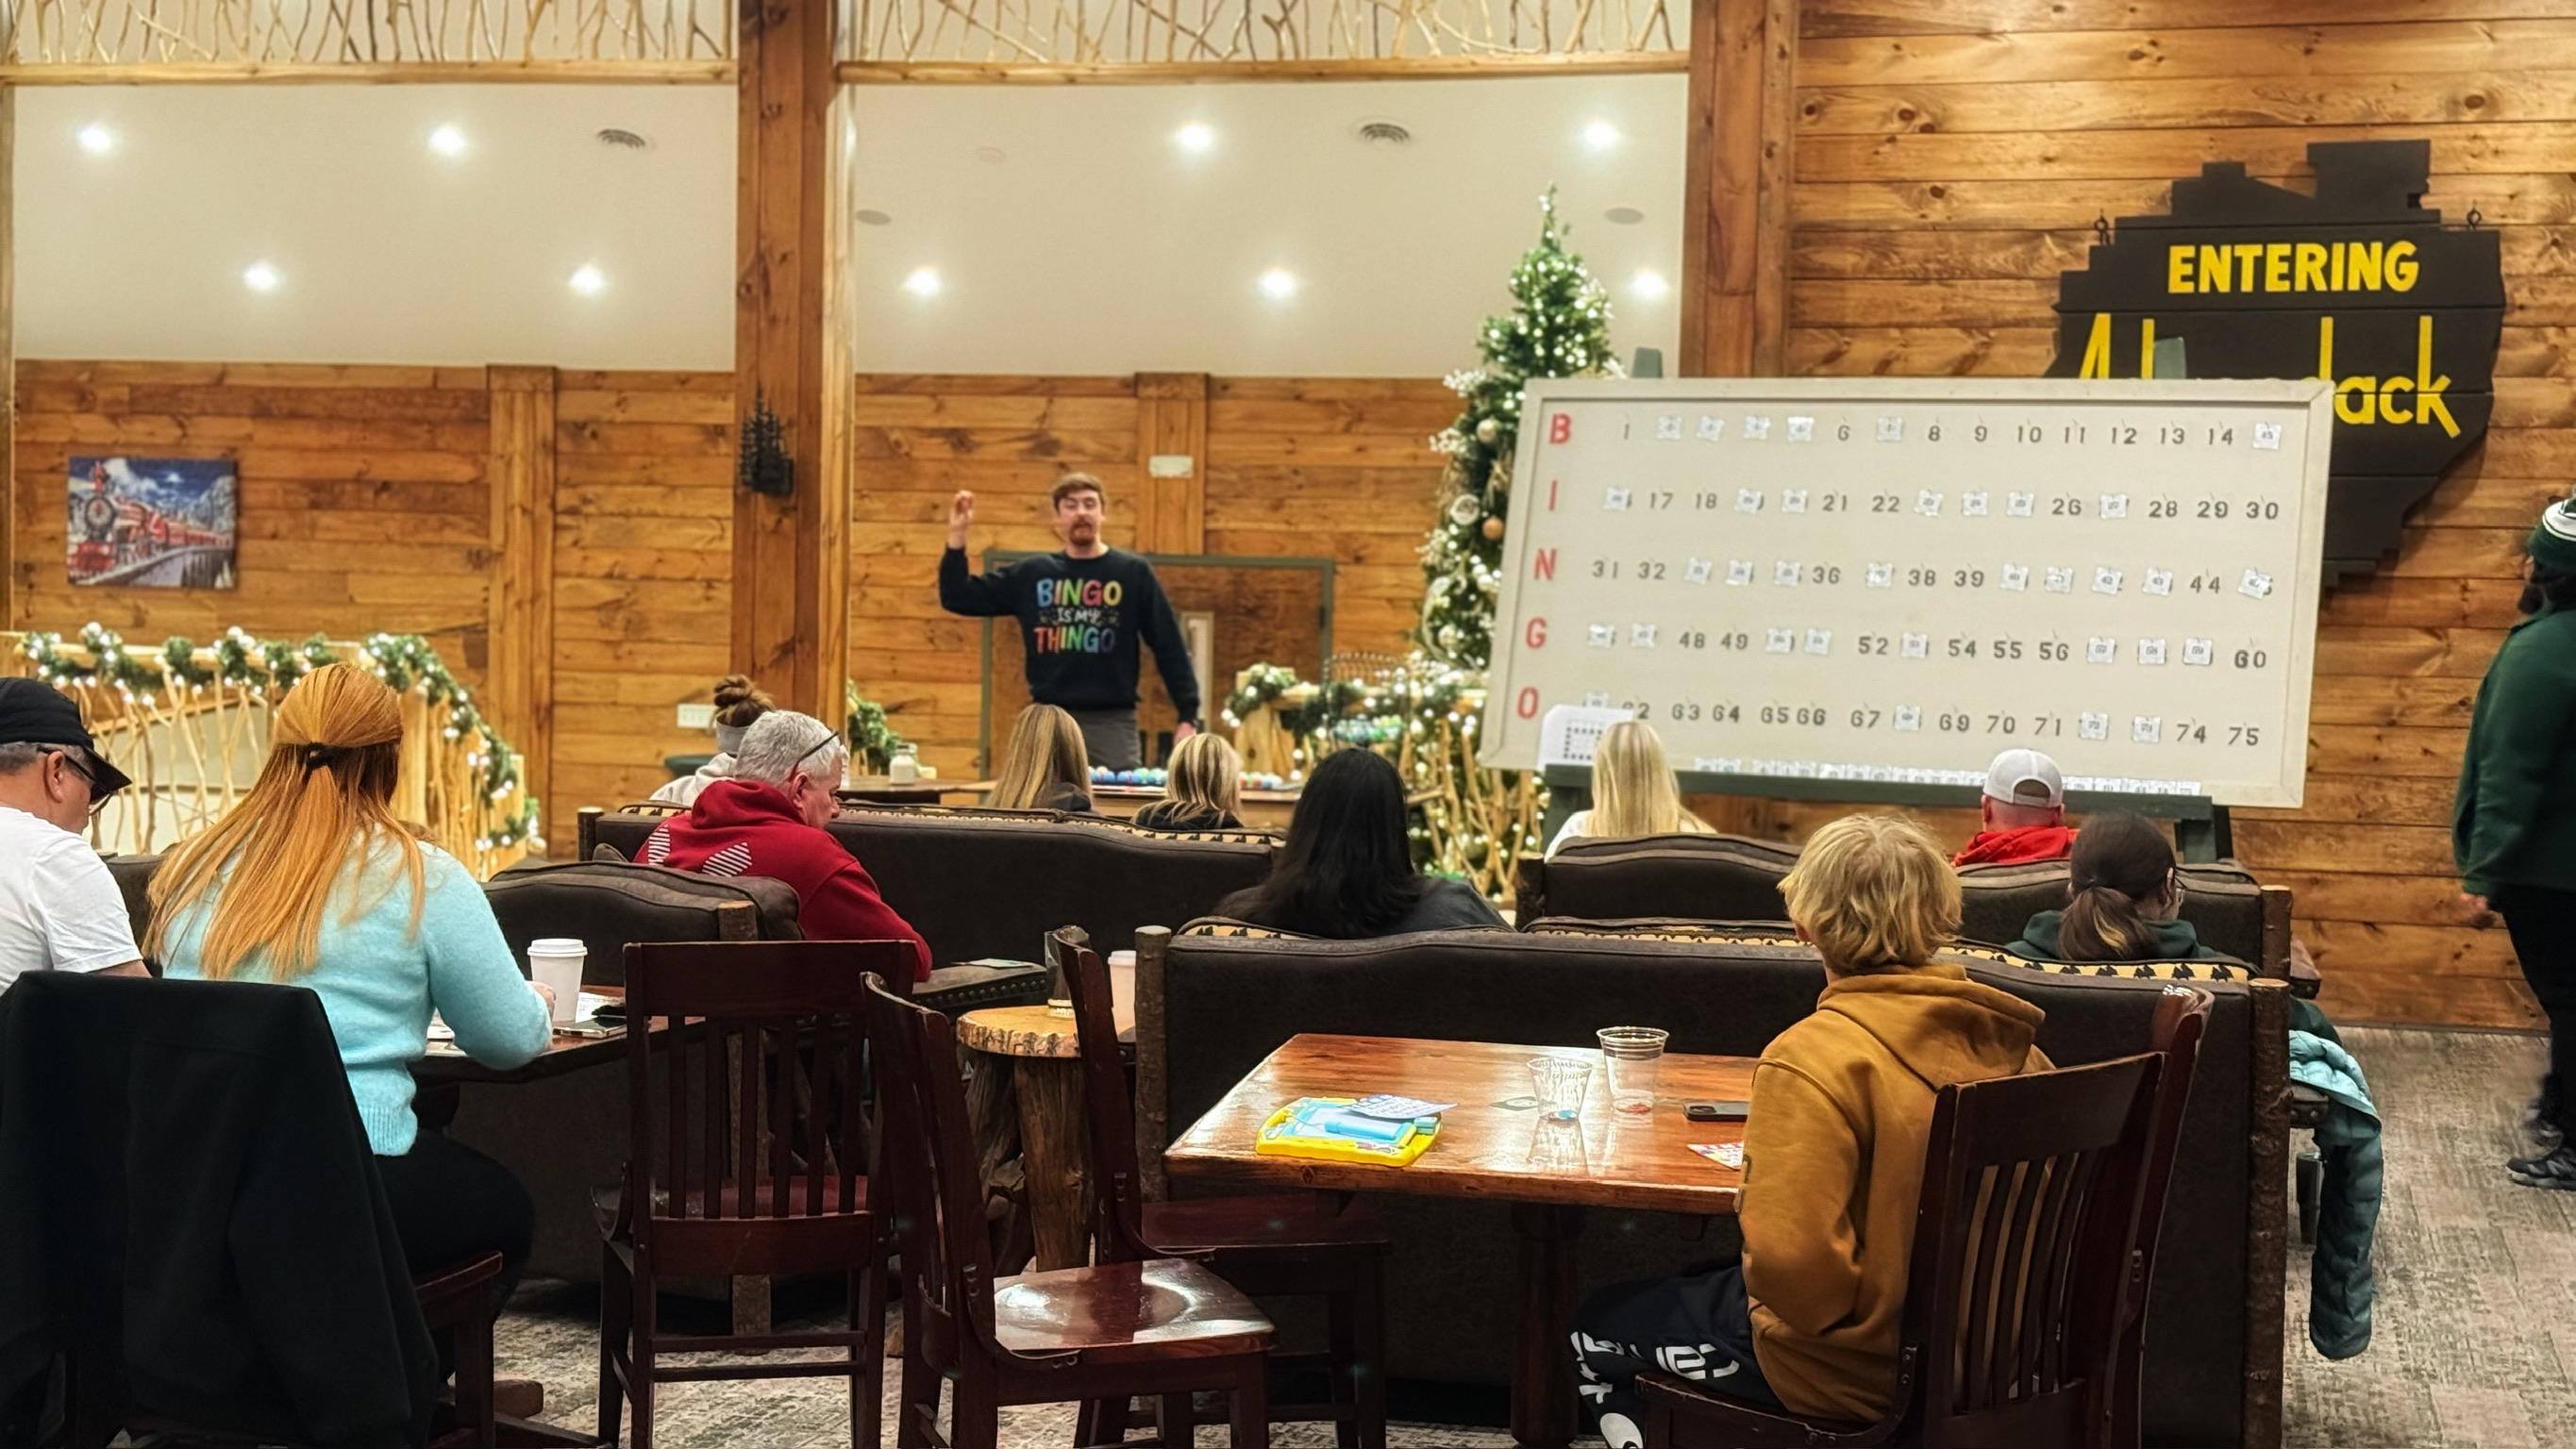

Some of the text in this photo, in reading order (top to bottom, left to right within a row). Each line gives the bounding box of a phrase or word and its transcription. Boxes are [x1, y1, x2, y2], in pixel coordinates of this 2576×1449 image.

[2168, 241, 2419, 294] ENTERING
[1548, 412, 1572, 445] B
[1623, 423, 1631, 441] 1
[1837, 425, 1850, 441] 6
[1928, 425, 1941, 442] 8
[1974, 425, 1988, 443] 9
[2017, 425, 2043, 444] 10
[2064, 425, 2086, 444] 11
[2111, 426, 2138, 445] 12
[2160, 426, 2185, 445] 13
[2208, 427, 2233, 446] 14
[1548, 479, 1558, 512] I
[1649, 491, 1674, 510] 17
[1696, 492, 1718, 510] 18
[1822, 493, 1848, 512] 21
[1871, 494, 1900, 513] 22
[2051, 497, 2083, 516] 26
[2148, 500, 2178, 519] 28
[2197, 500, 2229, 519] 29
[2246, 501, 2280, 521] 30
[1533, 547, 1557, 581] N
[1592, 559, 1618, 579] 31
[1637, 561, 1666, 580] 32
[1812, 565, 1841, 585] 36
[1908, 569, 1936, 587] 38
[1953, 570, 1985, 588] 39
[2189, 575, 2221, 594] 44
[1036, 578, 1122, 607] BINGO
[1057, 607, 1101, 625] IS MY
[1034, 624, 1115, 654] THINGO
[1525, 616, 1548, 650] G
[1679, 631, 1706, 649] 48
[1720, 632, 1748, 651] 49
[1858, 635, 1889, 656] 52
[1948, 639, 1977, 658] 54
[1993, 640, 2023, 660] 55
[2039, 641, 2069, 662] 56
[2233, 649, 2267, 670] 60
[1516, 687, 1540, 720] O
[1671, 703, 1700, 722] 63
[1713, 705, 1740, 724] 64
[1760, 706, 1790, 724] 65
[1796, 708, 1827, 726] 66
[1849, 709, 1882, 729] 67
[1938, 713, 1970, 733] 69
[1986, 714, 2016, 735] 70
[2034, 716, 2062, 737] 71
[2176, 724, 2207, 744] 74
[2228, 726, 2260, 747] 75
